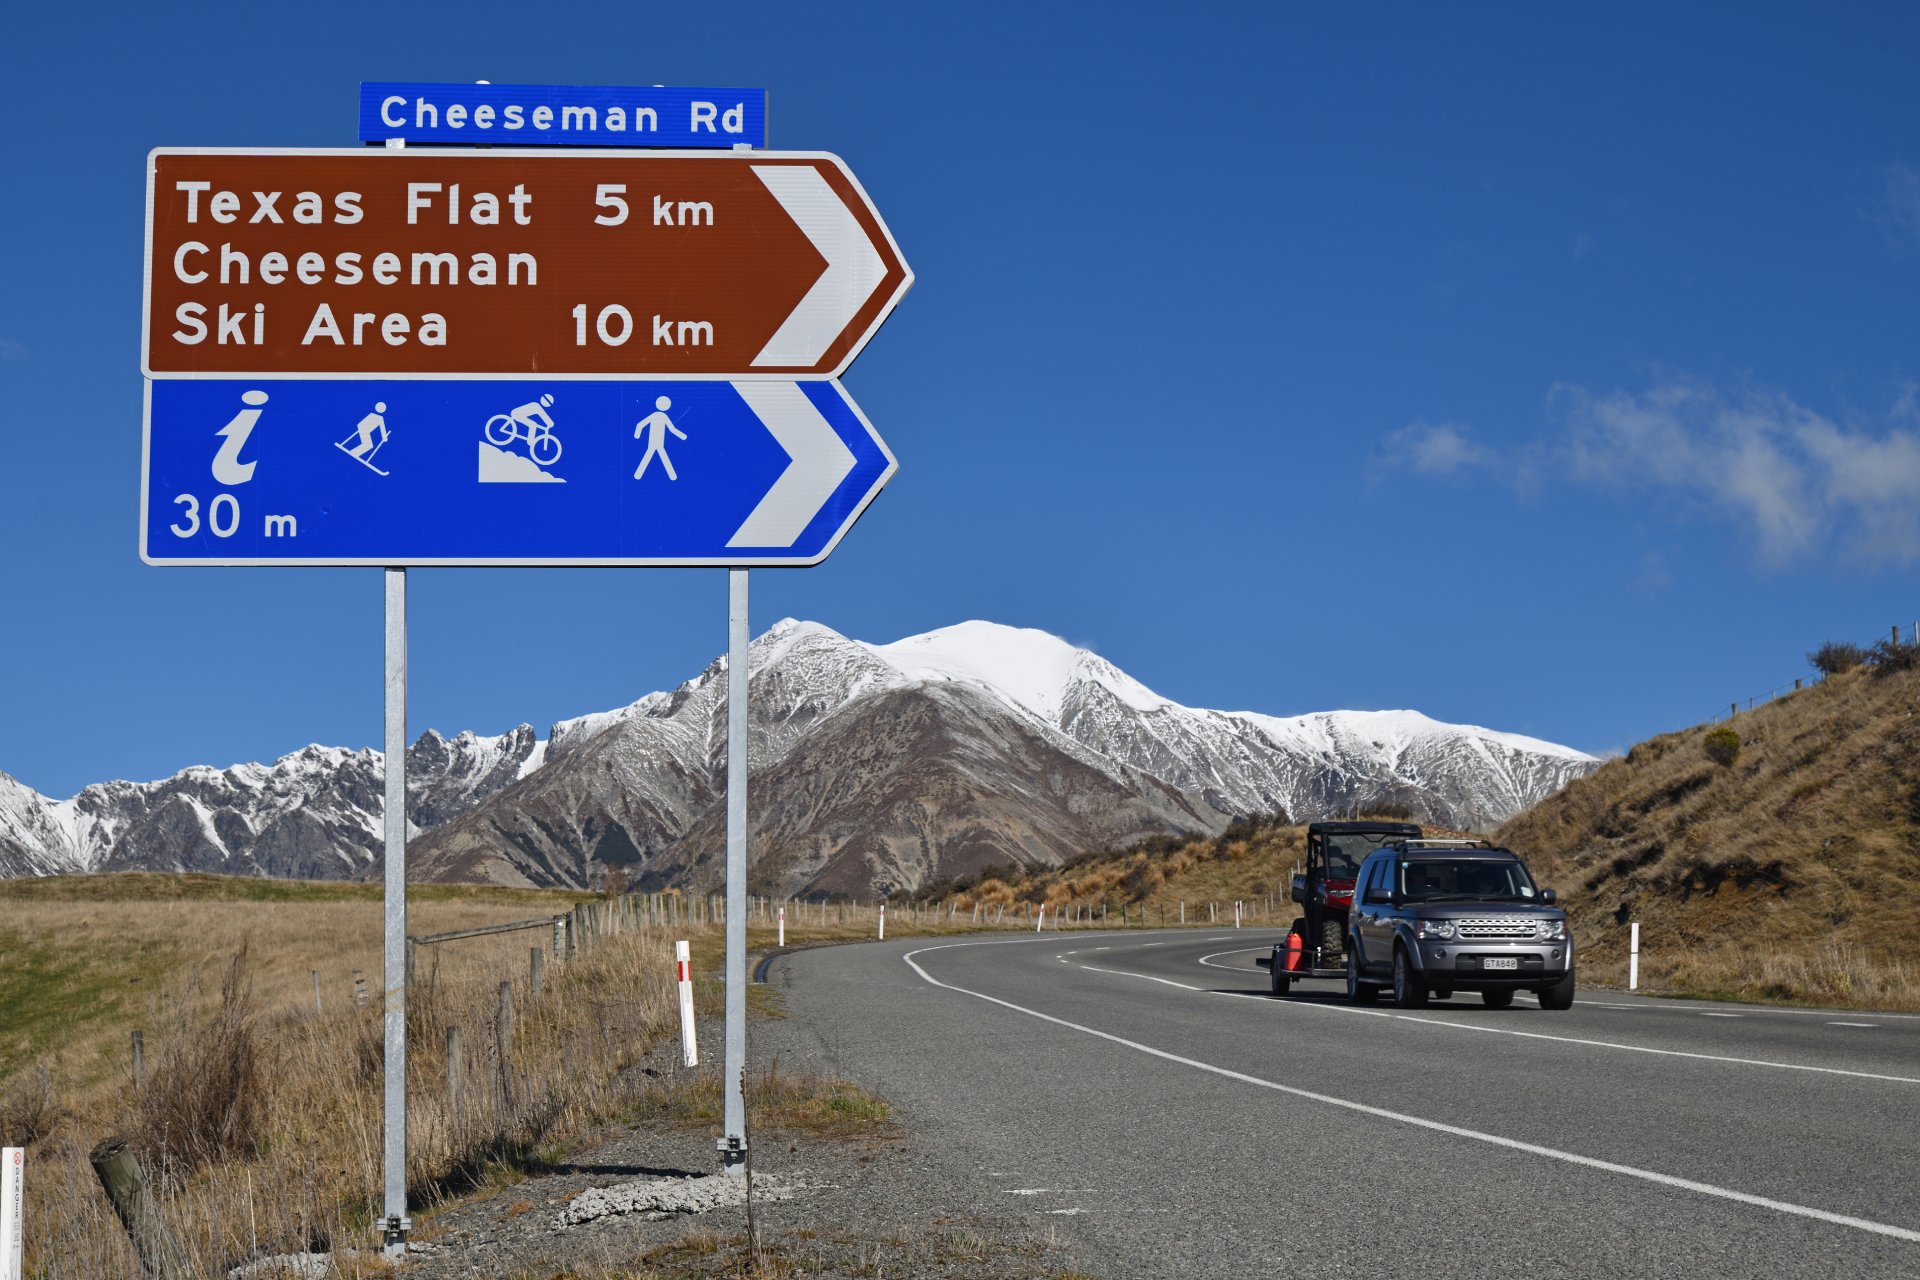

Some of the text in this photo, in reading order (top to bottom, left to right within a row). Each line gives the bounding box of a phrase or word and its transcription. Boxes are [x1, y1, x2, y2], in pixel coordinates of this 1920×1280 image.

[380, 95, 744, 134] Cheeseman Rd
[175, 181, 714, 227] Texas Flat 5 km
[173, 241, 537, 286] Cheeseman
[172, 302, 714, 347] Ski Area 10 km
[170, 493, 297, 538] 30 m
